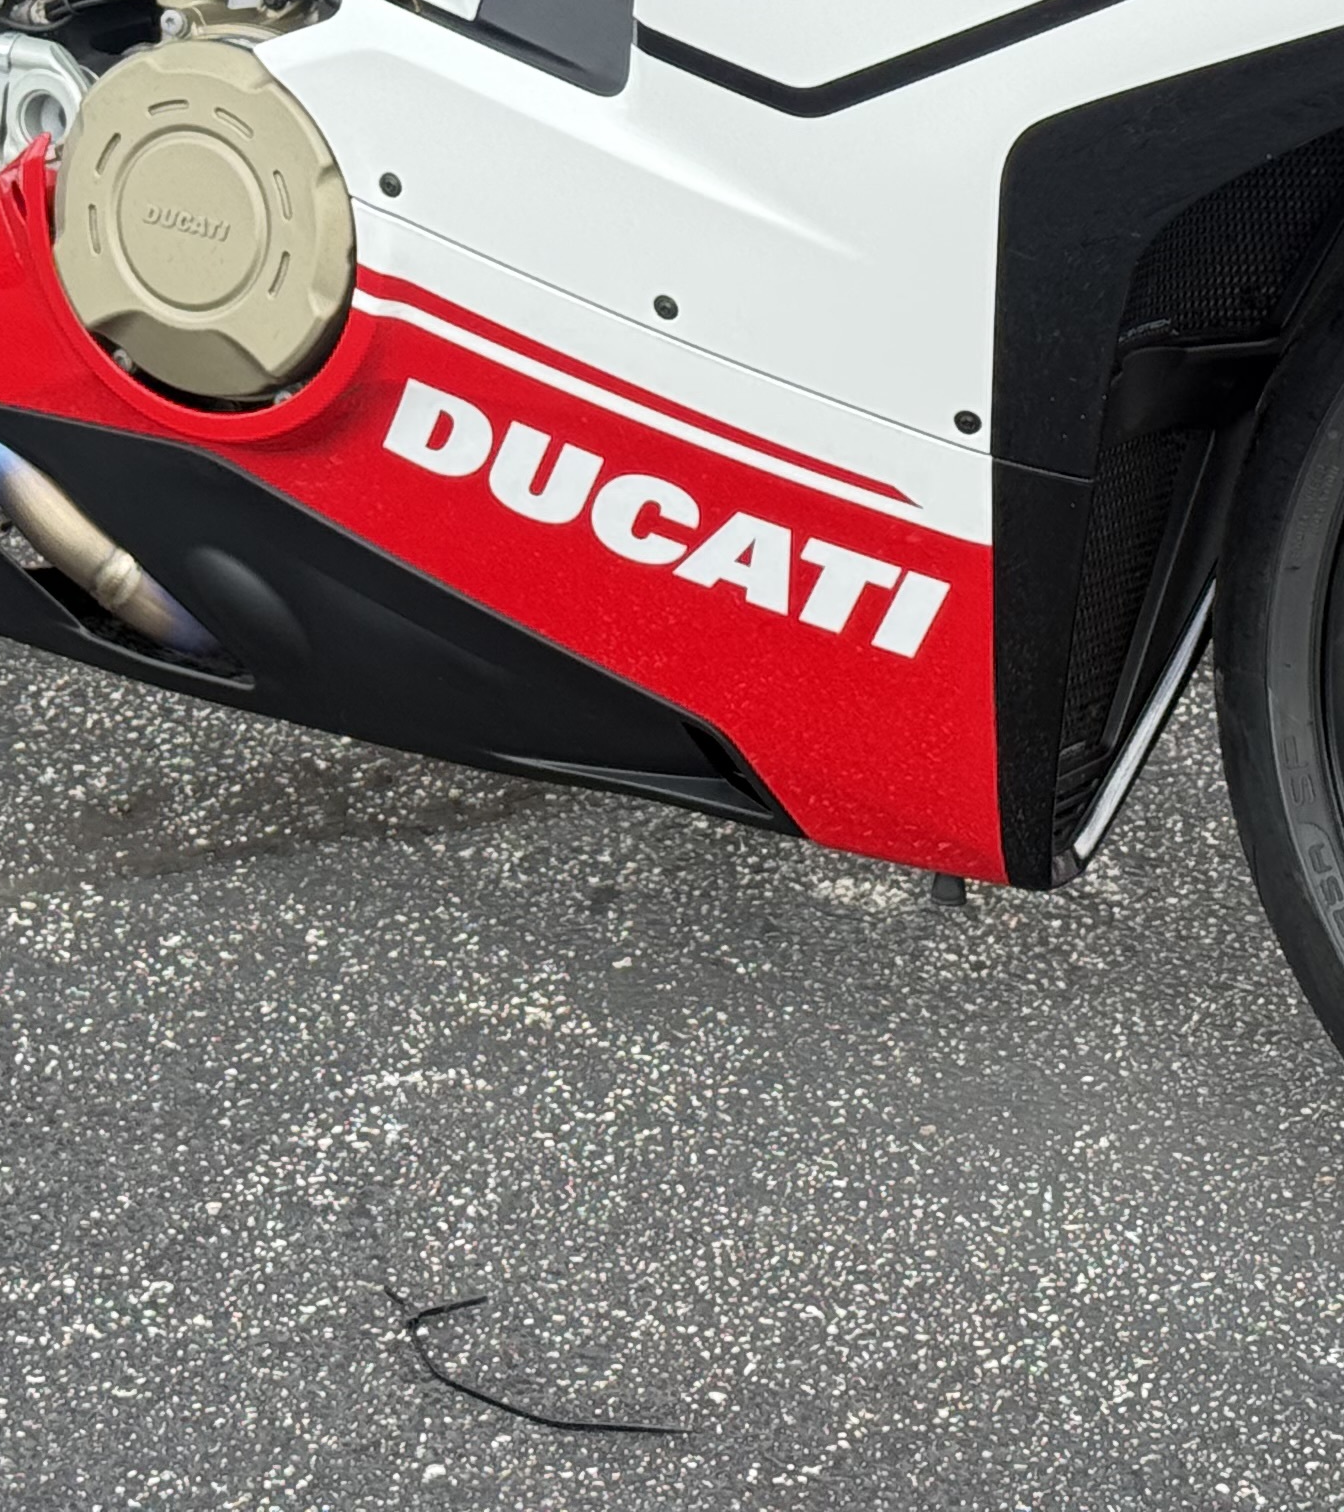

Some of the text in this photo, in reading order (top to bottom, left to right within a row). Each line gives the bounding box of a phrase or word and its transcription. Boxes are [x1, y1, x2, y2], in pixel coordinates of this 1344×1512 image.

[142, 204, 230, 243] DUCATI
[382, 377, 952, 659] DUCATI
[1280, 734, 1318, 807] SP
